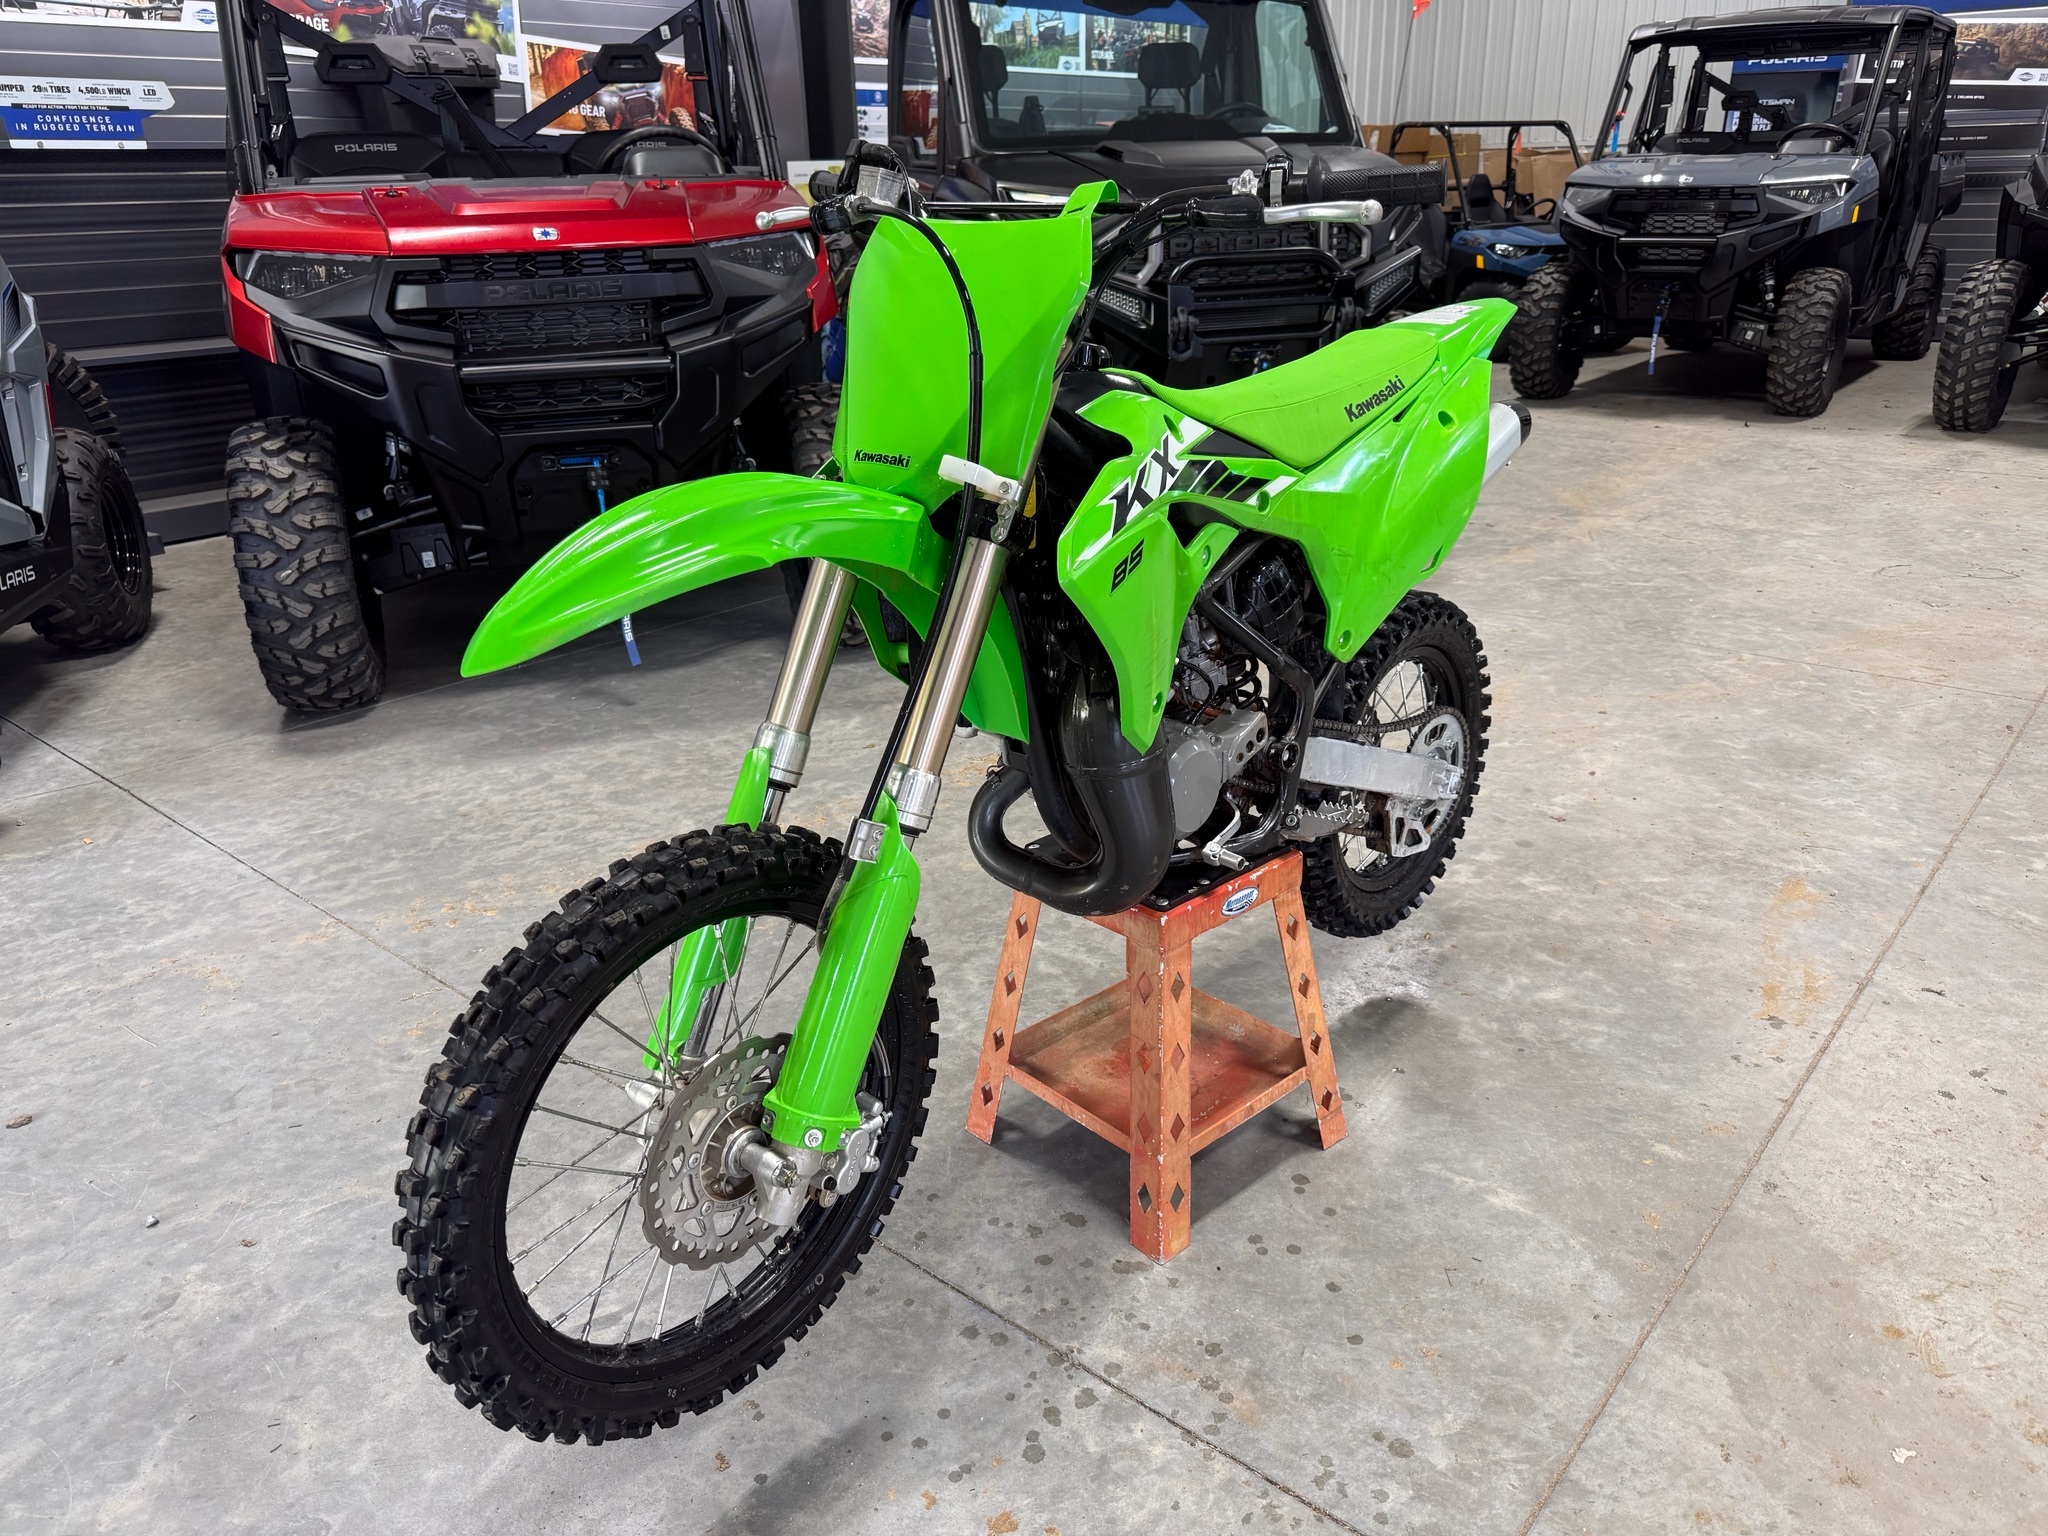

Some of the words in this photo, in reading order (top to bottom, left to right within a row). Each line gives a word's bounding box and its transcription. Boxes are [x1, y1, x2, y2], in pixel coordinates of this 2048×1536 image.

[0, 84, 25, 93] UMPER
[50, 86, 71, 94] TIRES
[107, 87, 131, 96] WINCH
[143, 88, 157, 97] LED
[580, 104, 606, 117] GEAR
[37, 115, 111, 123] CONFIDENCE
[15, 123, 28, 131] IN
[34, 123, 80, 132] RUGGED
[86, 124, 136, 132] TERRAIN
[334, 143, 398, 153] POLARIS
[1169, 228, 1310, 258] POLARIS
[483, 278, 624, 301] POLARIS
[1344, 374, 1405, 422] Kawasaki
[854, 449, 911, 468] Kawasaki
[1108, 433, 1180, 538] KX
[1110, 538, 1146, 595] 85
[0, 565, 36, 591] LARIS
[623, 613, 634, 642] ARIS
